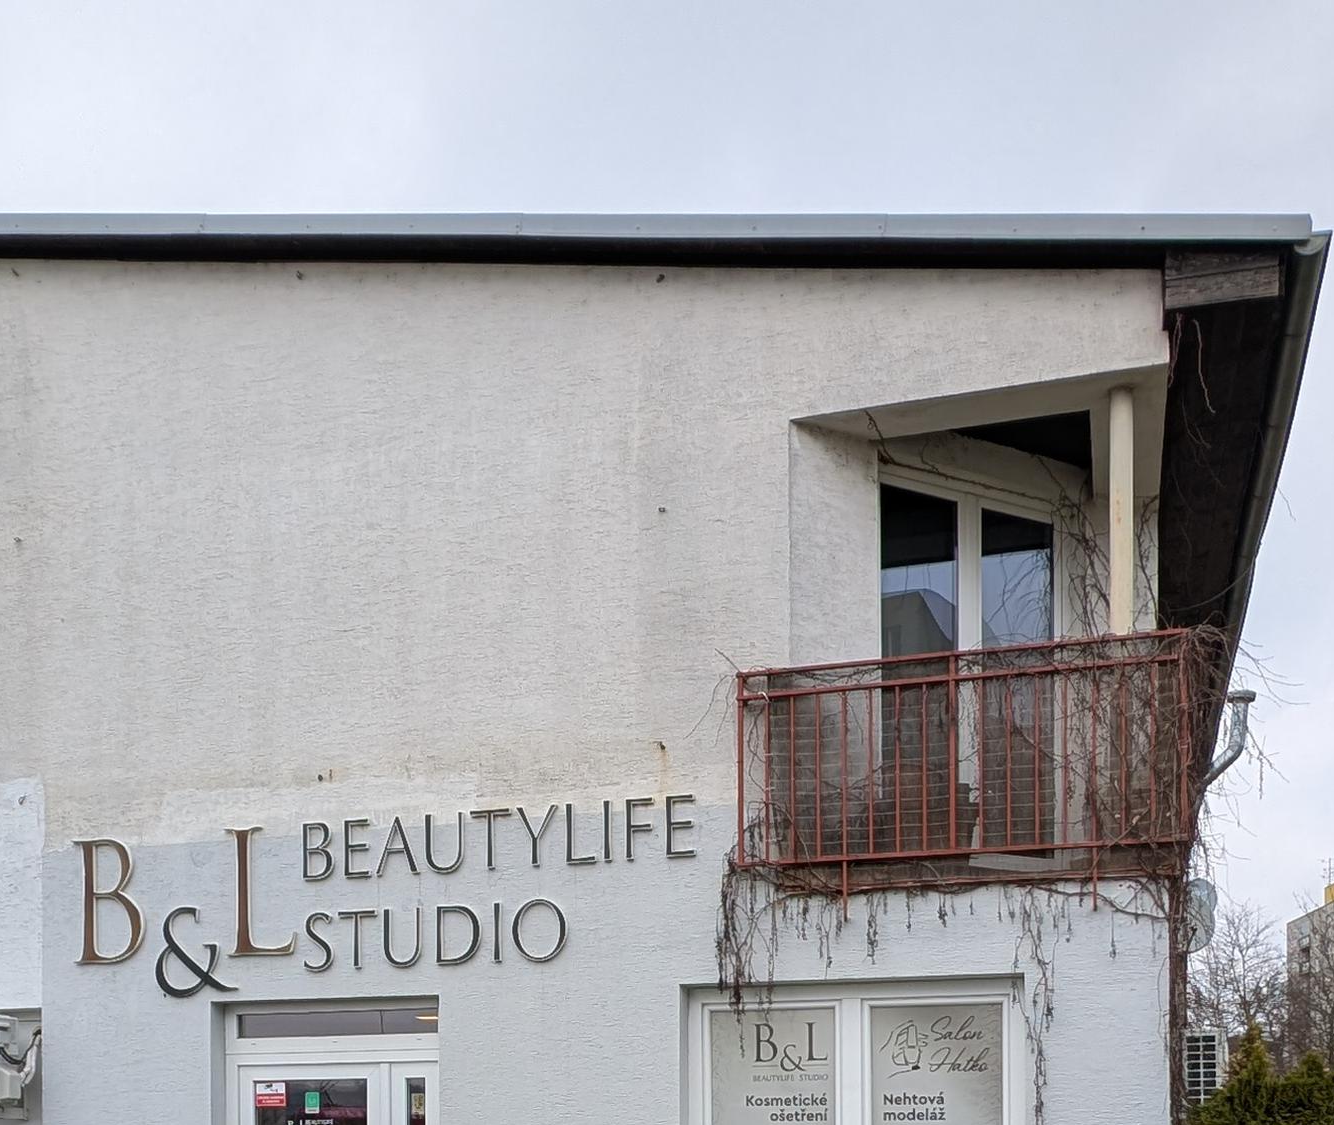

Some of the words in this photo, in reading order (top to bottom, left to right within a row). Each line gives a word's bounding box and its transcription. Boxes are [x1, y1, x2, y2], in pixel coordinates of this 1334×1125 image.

[301, 793, 698, 882] BEAUTYLIFE
[302, 898, 570, 973] STUDIO
[930, 1015, 984, 1042] Salon
[752, 1074, 795, 1082] BEAUTYLIFE
[799, 1073, 829, 1081] STUDIO
[745, 1092, 828, 1107] Kosmetické
[883, 1091, 945, 1106] Nehtová
[769, 1107, 828, 1122] ošetření
[883, 1107, 946, 1121] modeláž
